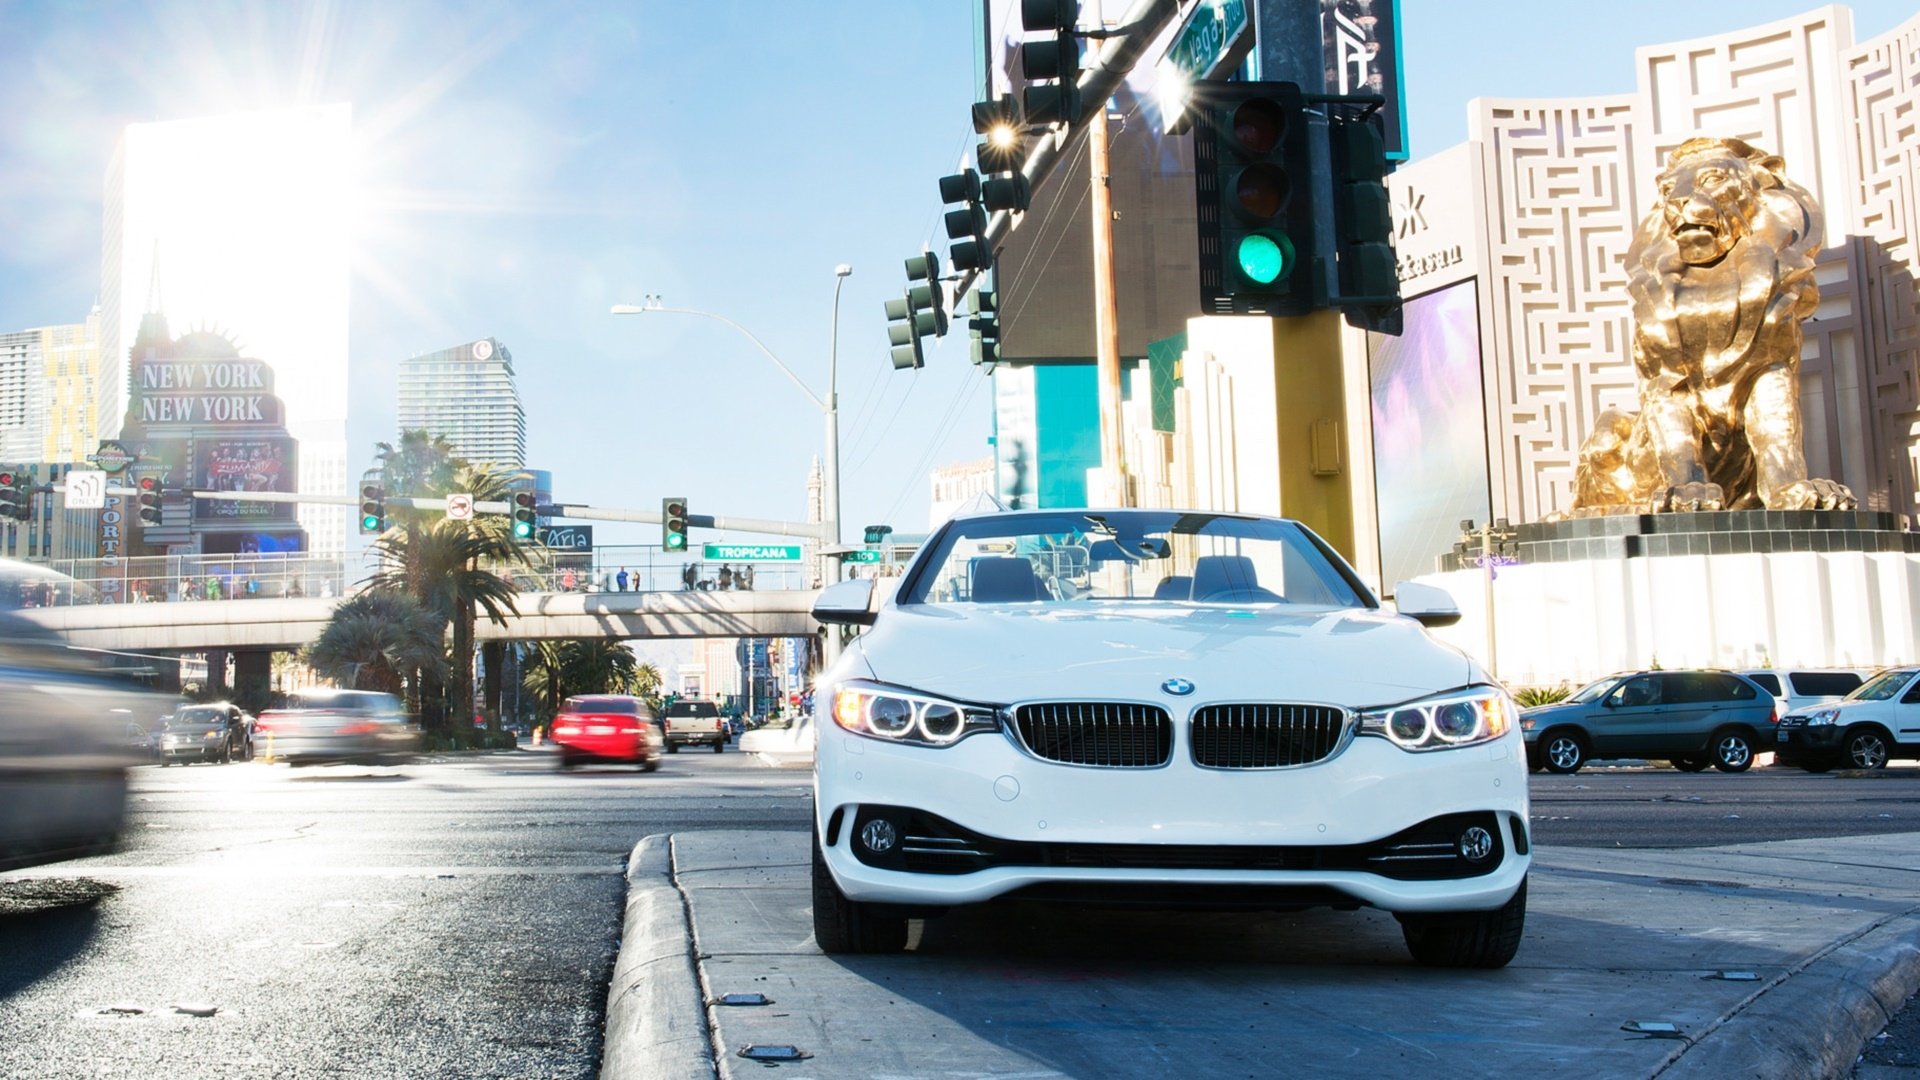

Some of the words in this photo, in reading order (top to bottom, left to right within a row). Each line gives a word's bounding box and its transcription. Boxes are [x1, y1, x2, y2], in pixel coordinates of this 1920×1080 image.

[143, 363, 196, 389] NEW
[200, 363, 264, 389] YORK
[141, 396, 195, 422] NEW
[200, 396, 263, 422] YORK
[72, 497, 97, 506] ONLY
[547, 529, 587, 548] Aria
[718, 547, 788, 558] TROPICANA
